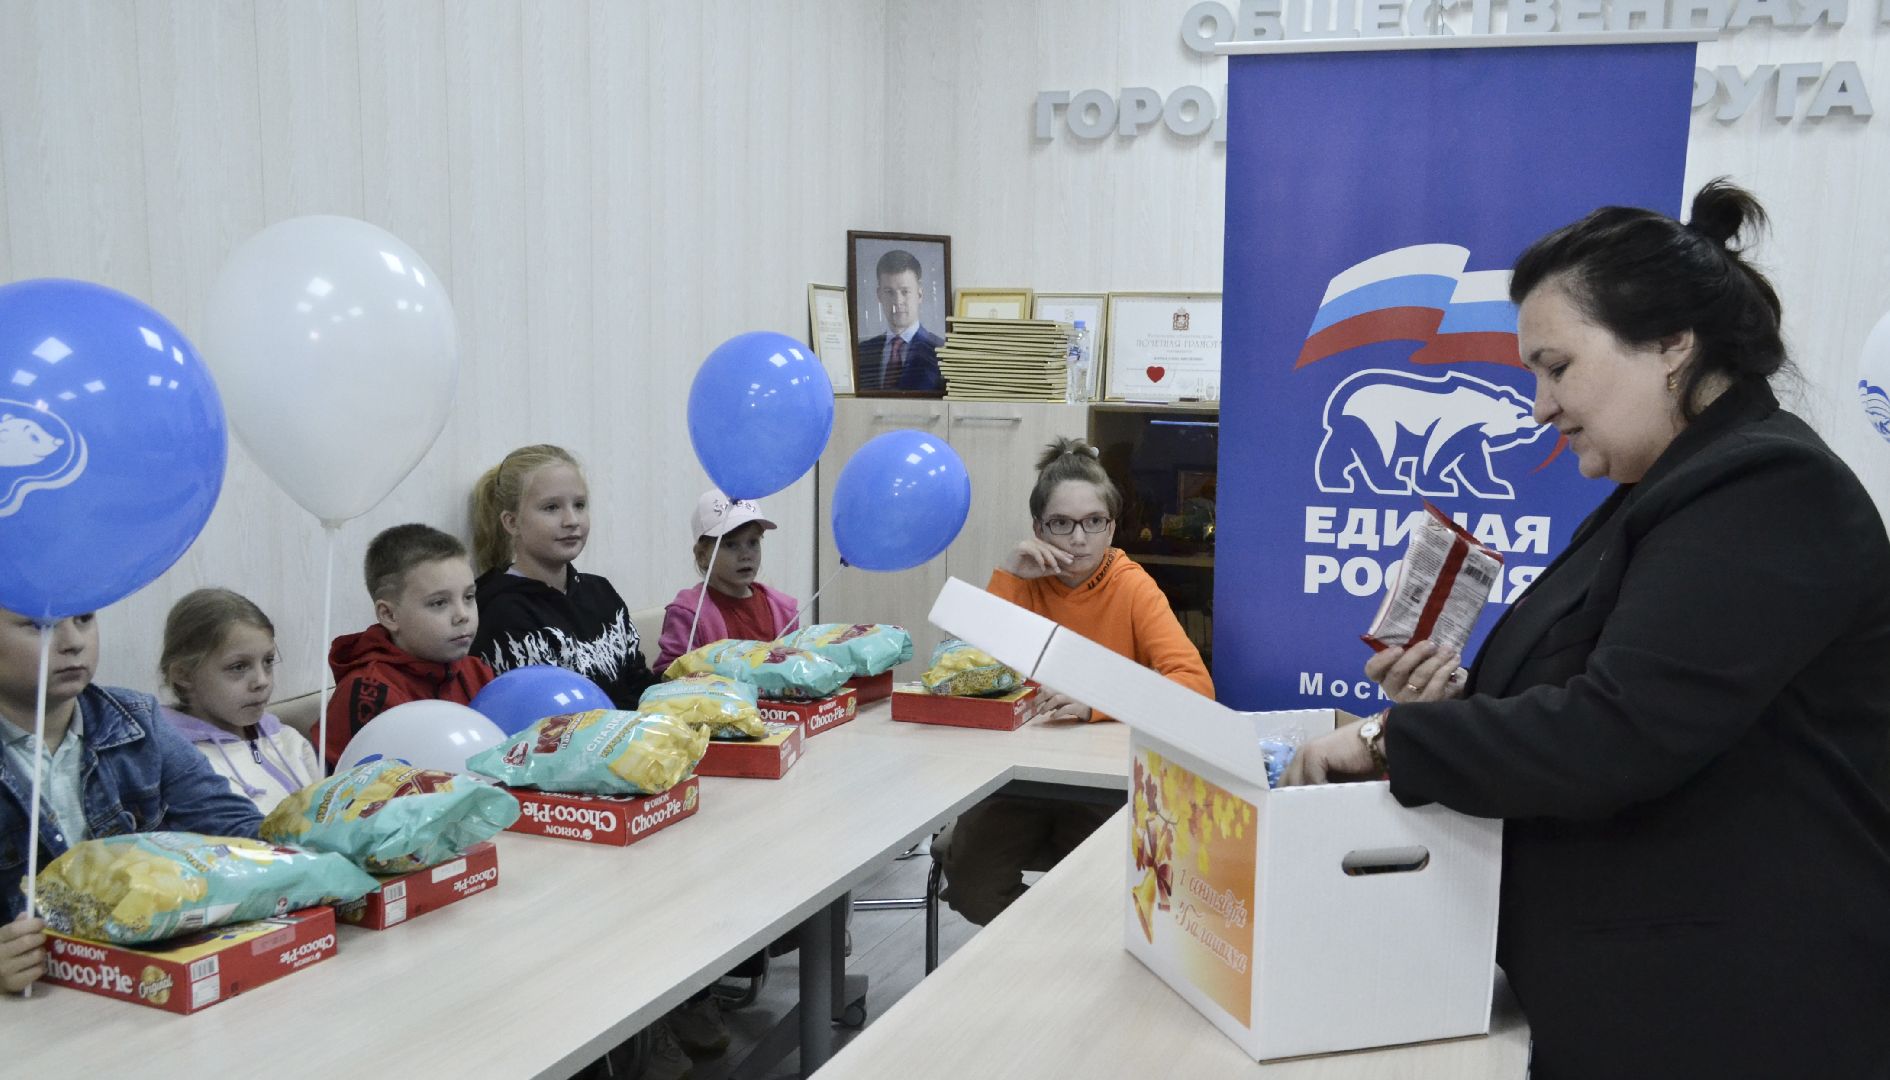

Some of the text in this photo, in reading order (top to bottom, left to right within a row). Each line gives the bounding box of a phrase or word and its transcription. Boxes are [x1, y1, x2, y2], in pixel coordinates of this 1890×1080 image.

[1184, 339, 1221, 349] ГРАМОТ
[1305, 506, 1551, 554] ЕДИАЯ
[545, 825, 581, 837] ORION
[67, 943, 107, 961] ORION
[46, 951, 133, 994] hoco-Pie
